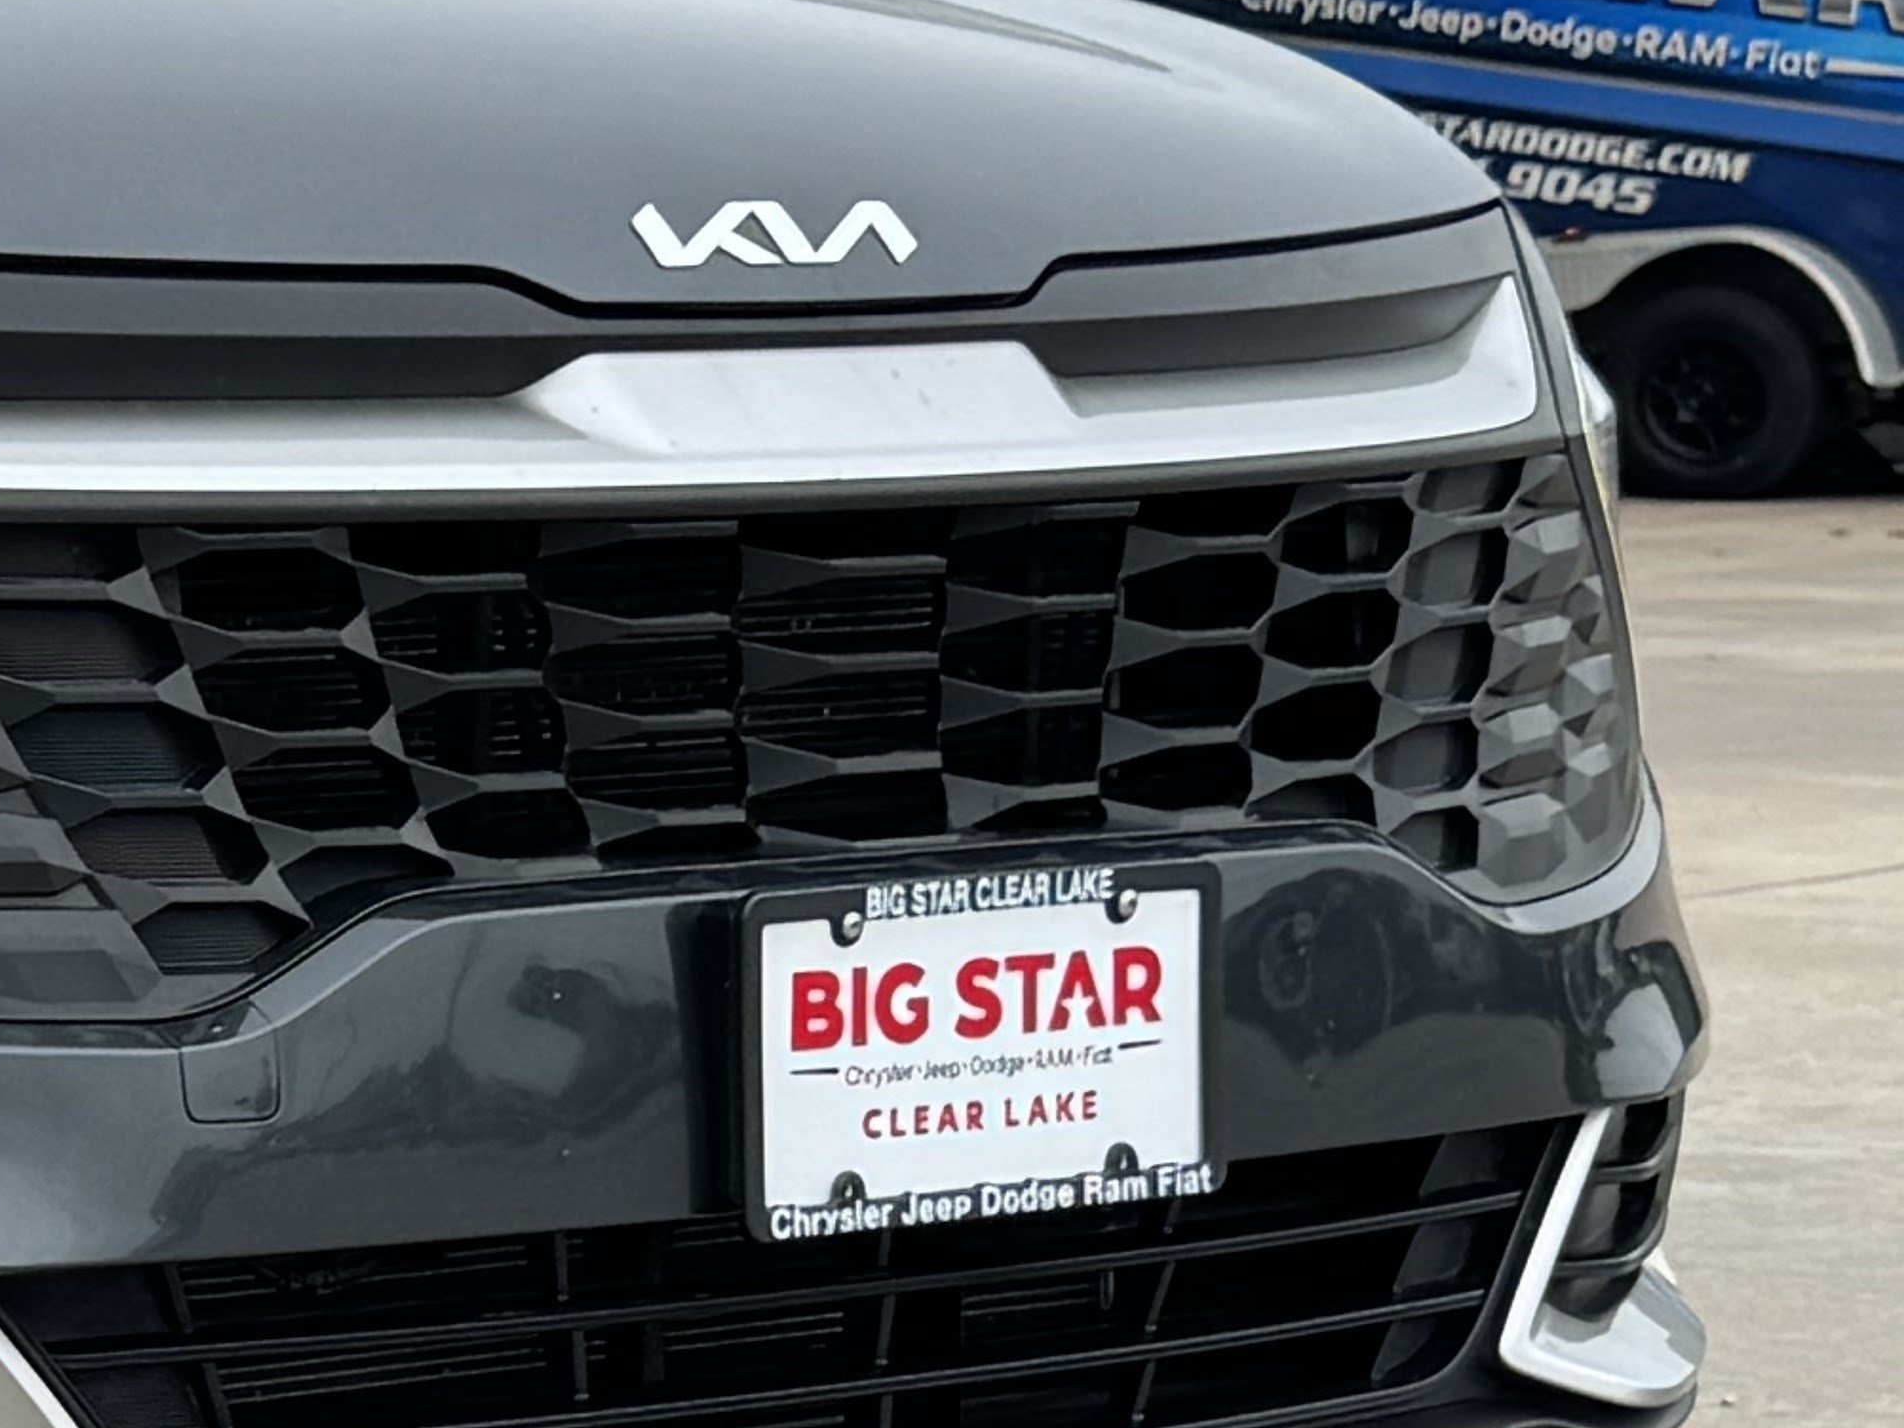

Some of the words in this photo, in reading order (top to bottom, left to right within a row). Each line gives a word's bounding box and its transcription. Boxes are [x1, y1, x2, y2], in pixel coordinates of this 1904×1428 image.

[1396, 5, 1486, 47] Jeep
[1501, 10, 1618, 61] Dodge
[1633, 28, 1726, 71] RAM
[1421, 111, 1755, 184] TARDODGE.COM
[1506, 162, 1663, 217] 9045
[630, 200, 918, 267] KIA
[867, 884, 904, 919] BIG
[912, 880, 971, 914] STAR
[977, 875, 1048, 909] CLEAR
[1056, 868, 1114, 903] LAKE
[790, 962, 929, 1051] BIG
[954, 946, 1162, 1040] STAR
[862, 1100, 985, 1139] CLEAR
[1004, 1089, 1097, 1127] LAKE
[770, 1193, 893, 1240] Chrysler
[900, 1188, 972, 1228] Jeep
[980, 1175, 1076, 1217] Dodge
[1083, 1170, 1148, 1207] Ram
[1157, 1161, 1214, 1198] Fiat
